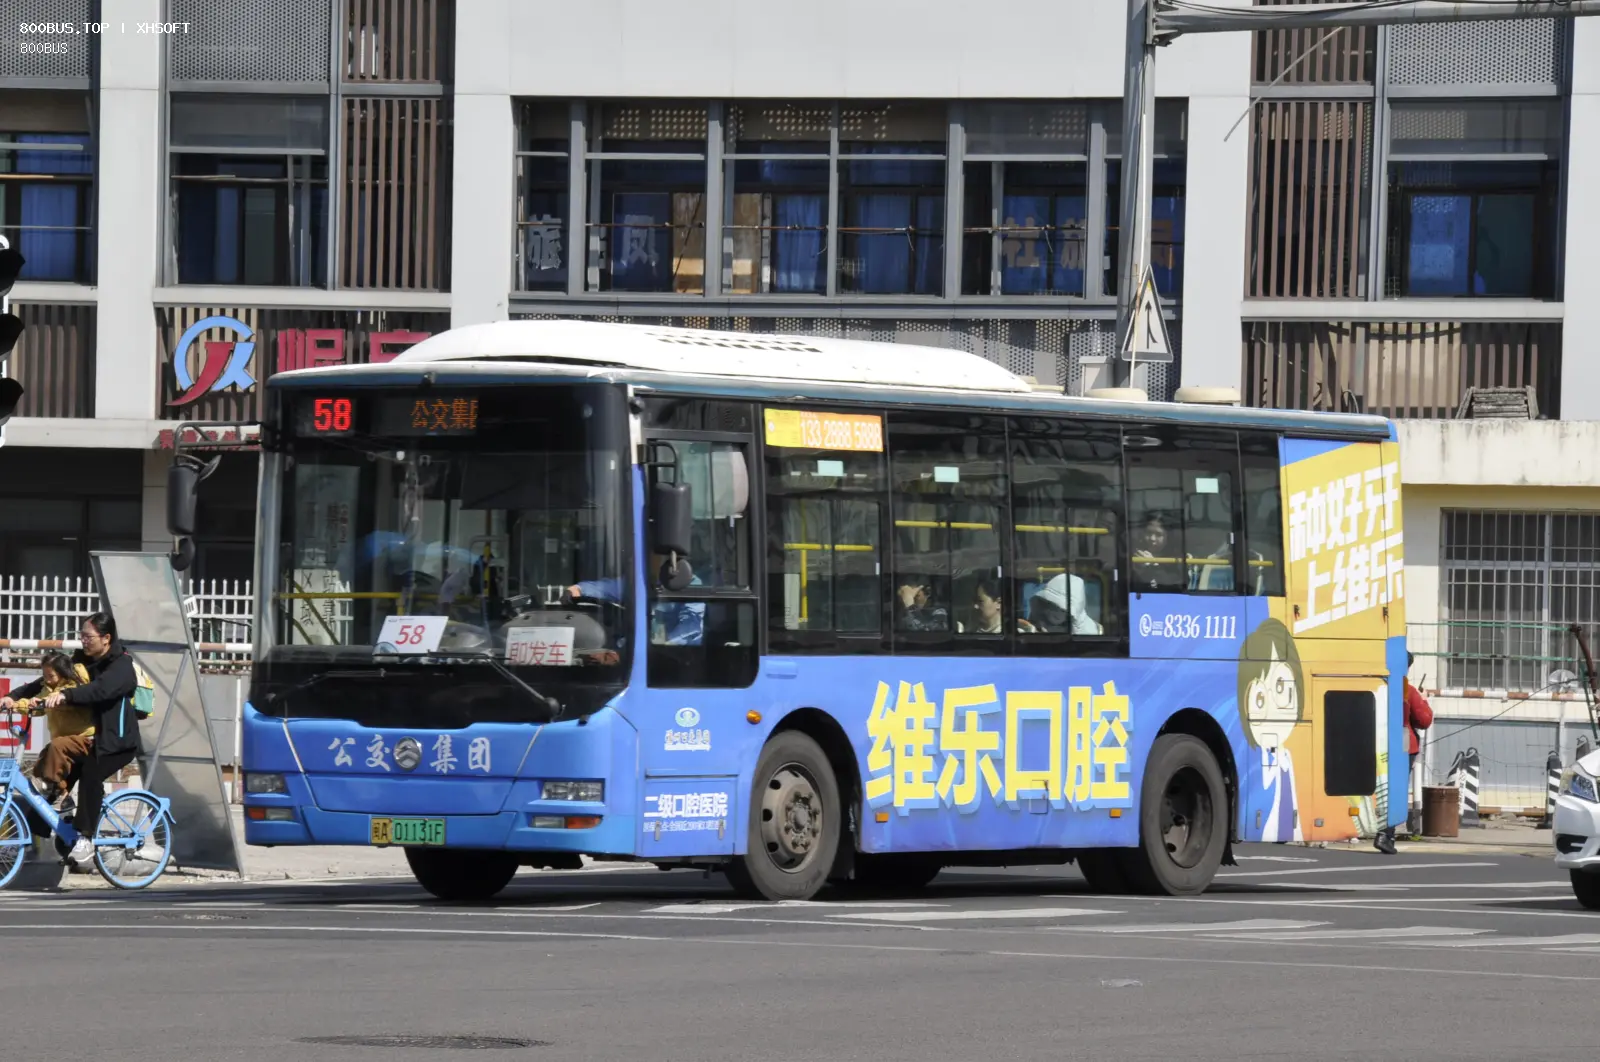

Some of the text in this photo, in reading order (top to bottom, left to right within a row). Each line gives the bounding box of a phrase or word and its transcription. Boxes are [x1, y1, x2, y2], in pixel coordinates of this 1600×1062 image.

[313, 398, 352, 431] 58
[1289, 461, 1399, 563] 种好牙
[1292, 530, 1404, 635] 上维乐
[395, 624, 426, 646] 58
[1163, 613, 1201, 639] 8336
[1203, 615, 1237, 639] 1111
[510, 641, 569, 666] 即发车
[327, 733, 492, 774] 公交集团
[865, 679, 1132, 815] 维乐口腔
[643, 792, 729, 818] 二级口腔医院
